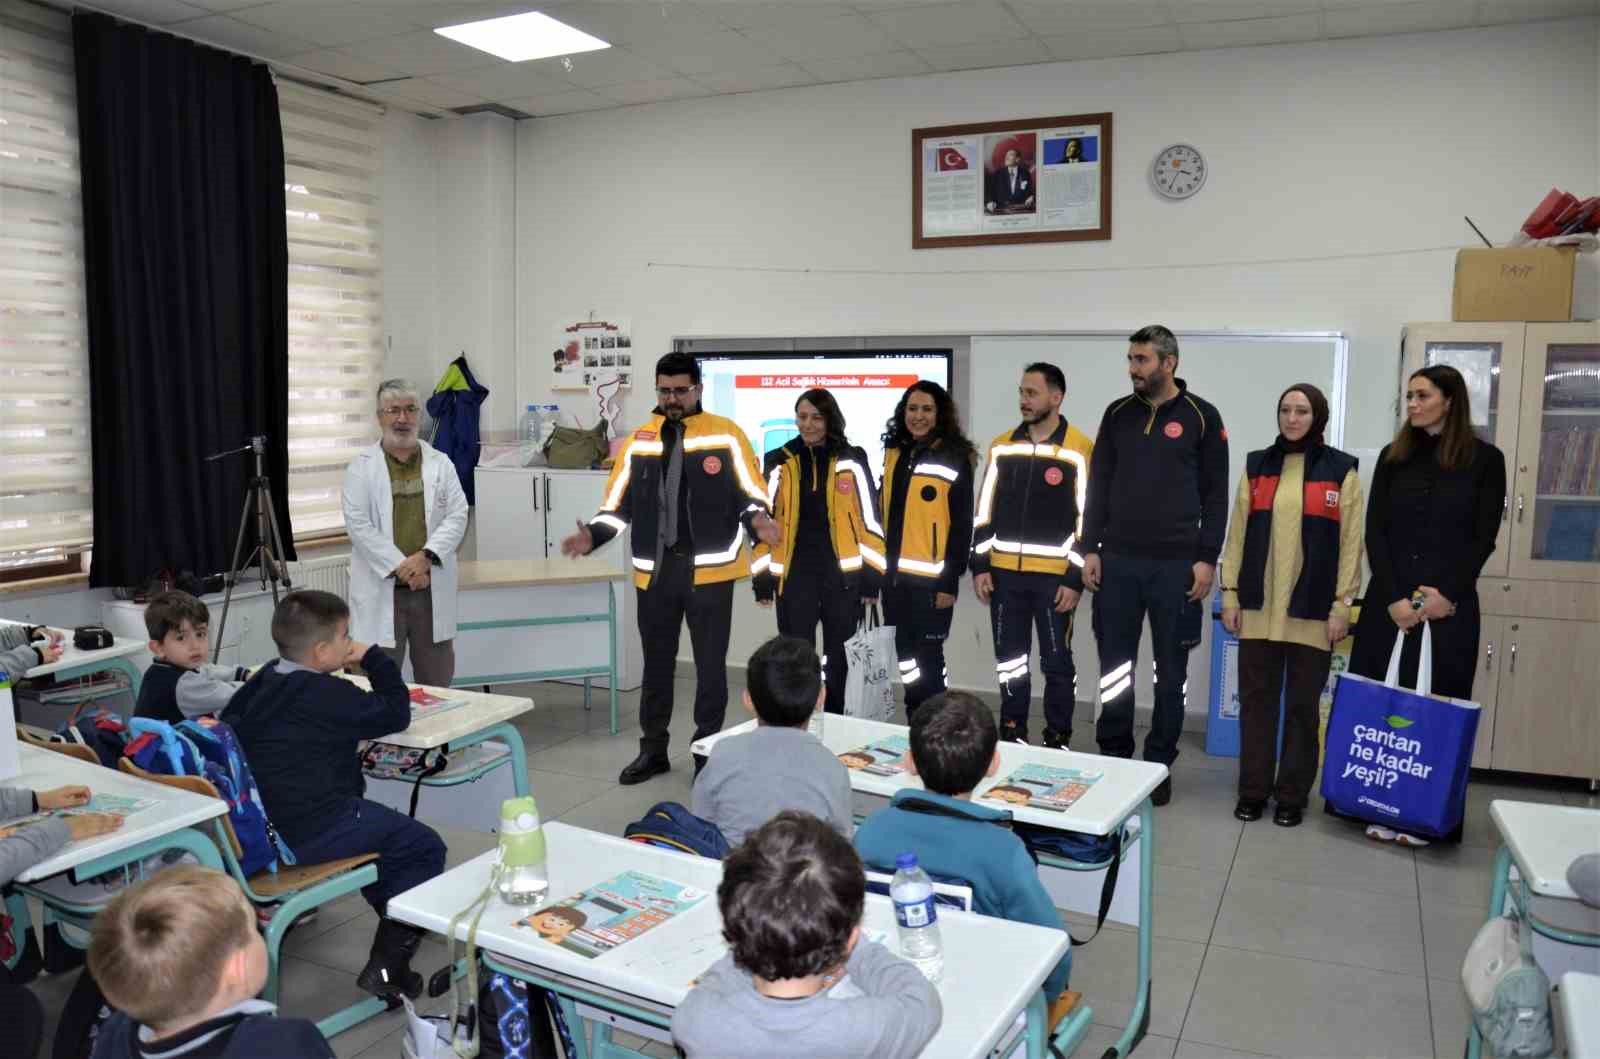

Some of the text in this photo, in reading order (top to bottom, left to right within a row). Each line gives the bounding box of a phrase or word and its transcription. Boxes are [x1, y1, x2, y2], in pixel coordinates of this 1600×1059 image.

[1353, 724, 1422, 755] çantan
[1341, 762, 1399, 789] yeşil?
[1349, 743, 1433, 779] ne kadar
